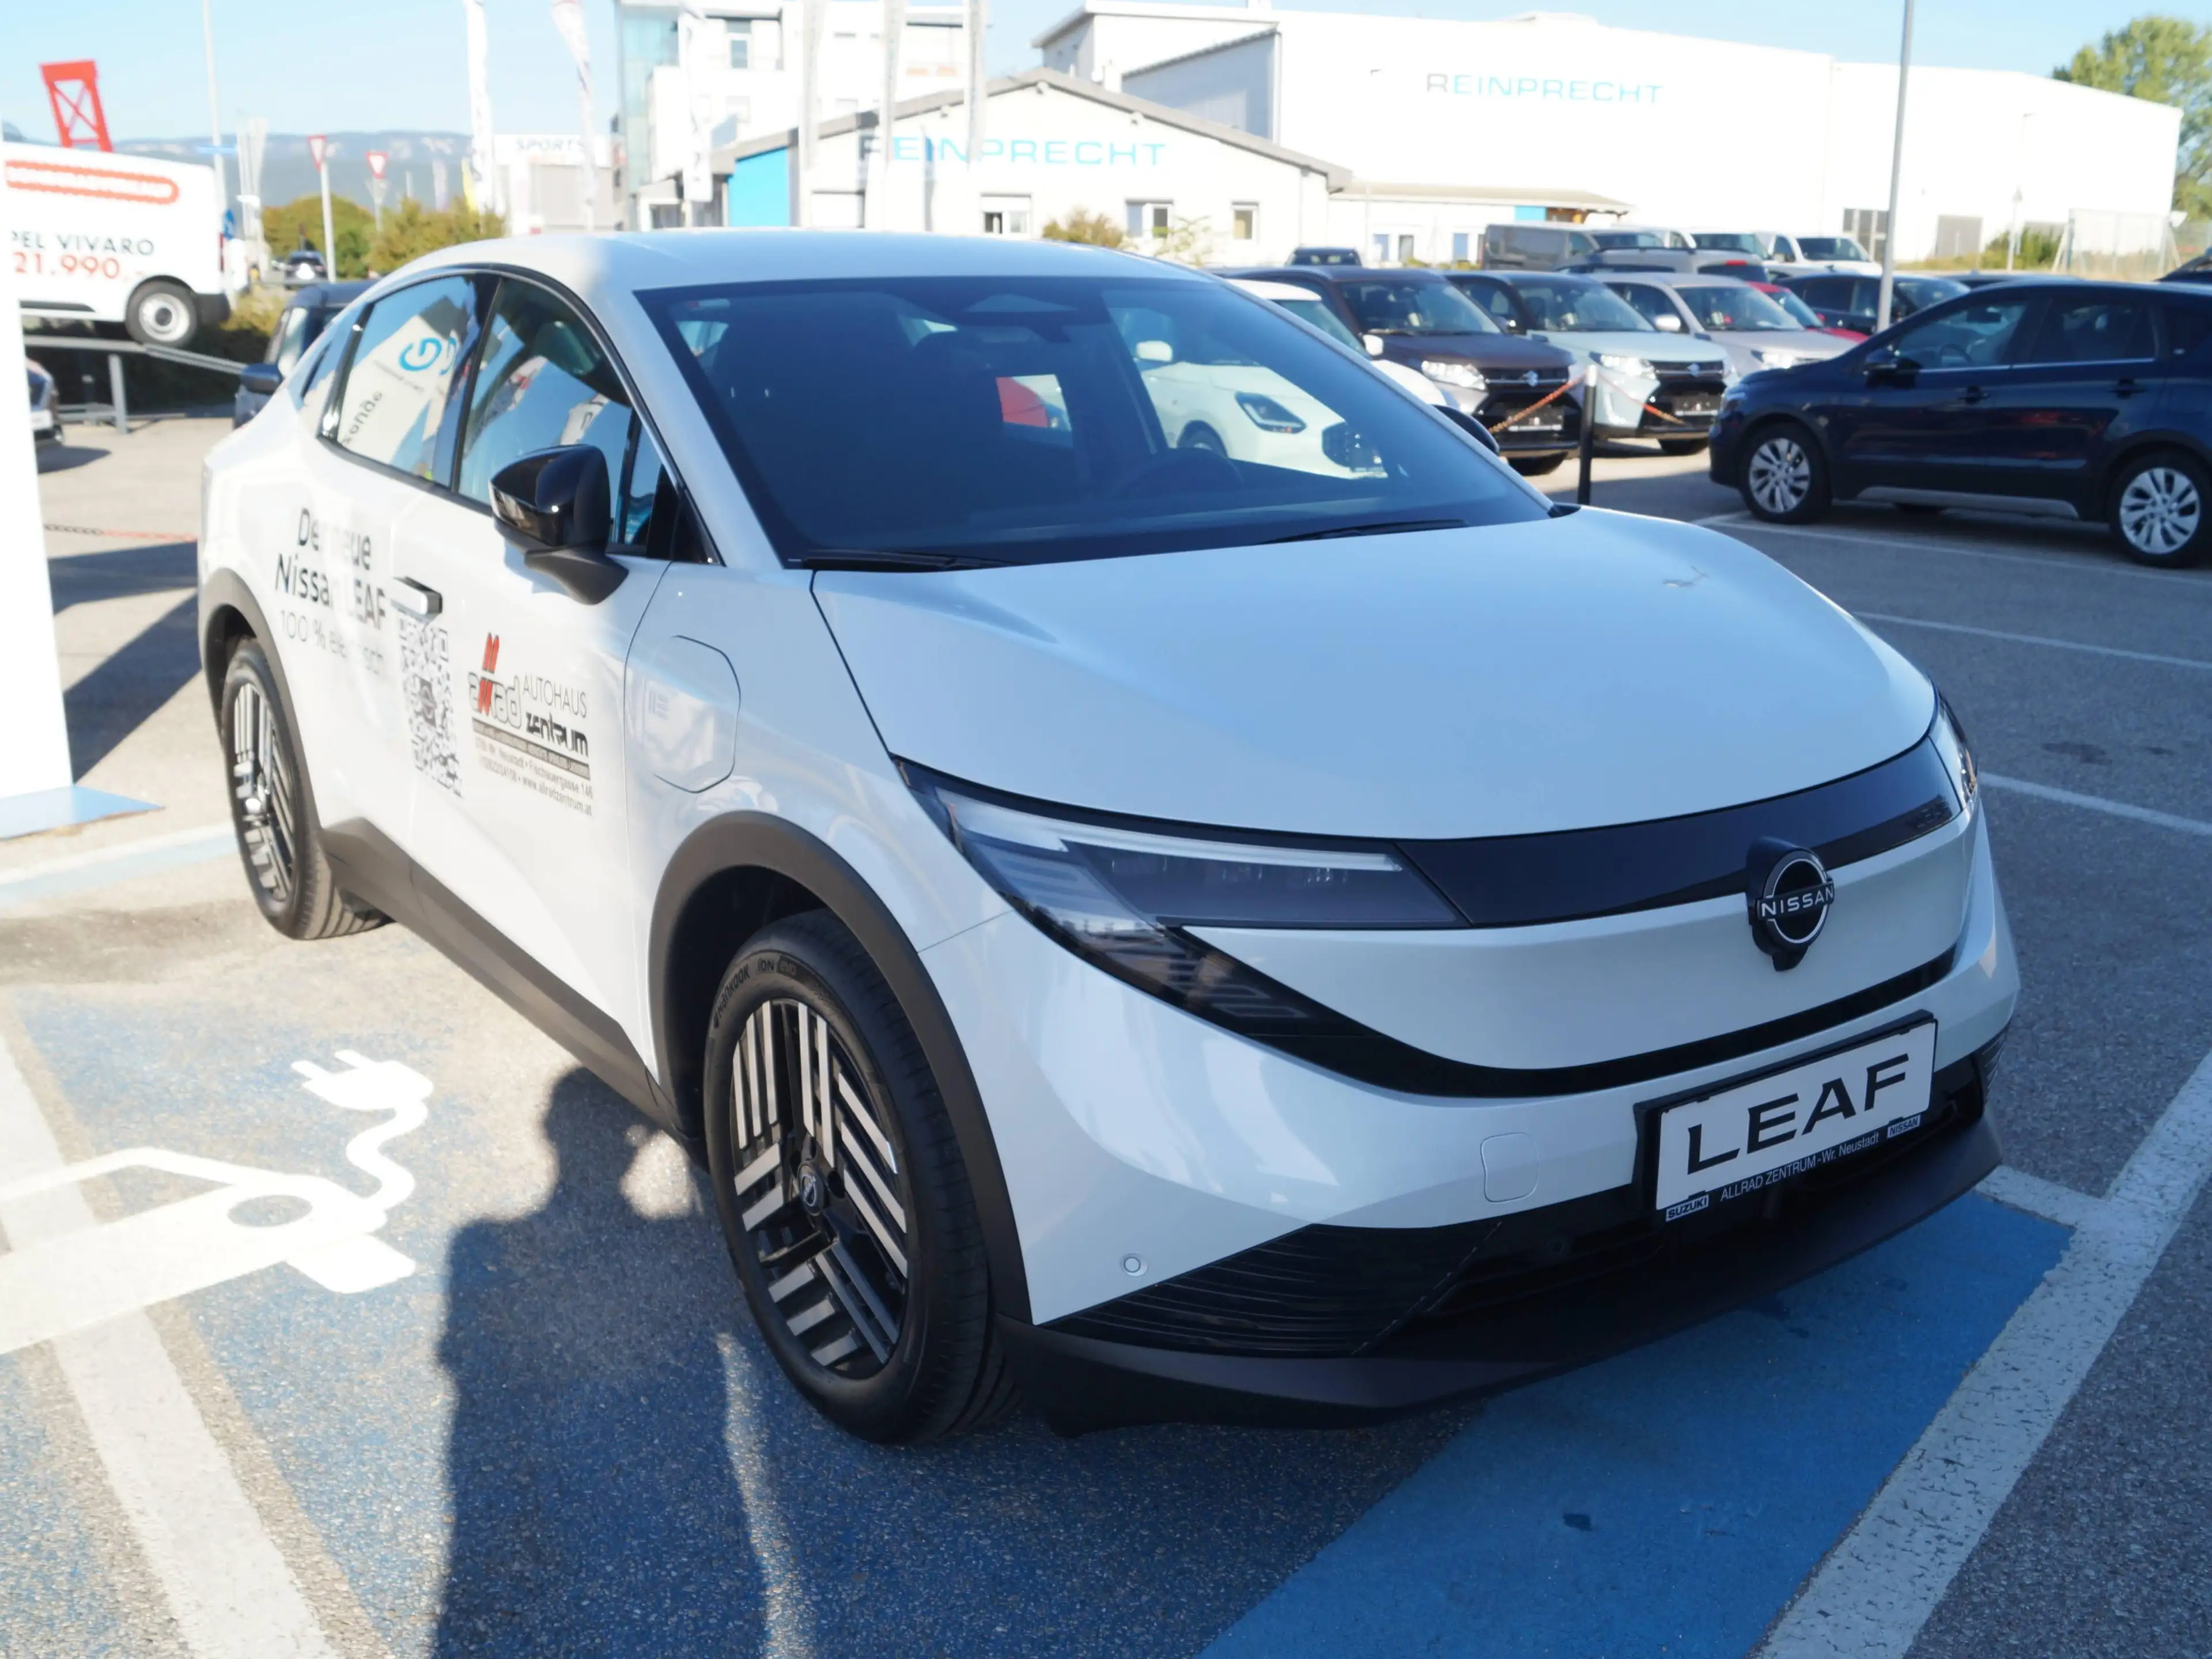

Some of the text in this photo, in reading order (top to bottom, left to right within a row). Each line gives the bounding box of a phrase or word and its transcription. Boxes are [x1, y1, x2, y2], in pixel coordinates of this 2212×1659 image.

[1426, 73, 1663, 104] REINPRECHT
[56, 233, 154, 256] VIVARO
[298, 507, 327, 551] De
[275, 553, 385, 630] Nissa EAF
[281, 610, 308, 642] 100
[312, 620, 326, 650] %
[467, 632, 589, 757] allrad zentrum
[523, 675, 587, 718] AUTOHAUS
[1761, 886, 1834, 918] NISSAN
[1687, 1053, 1909, 1175] LEAF
[1667, 1197, 1708, 1219] SUZUKI
[1720, 1176, 1764, 1202] ALLRAD
[1839, 1132, 1880, 1158] Neustadt
[1889, 1117, 1918, 1137] NISSAN
